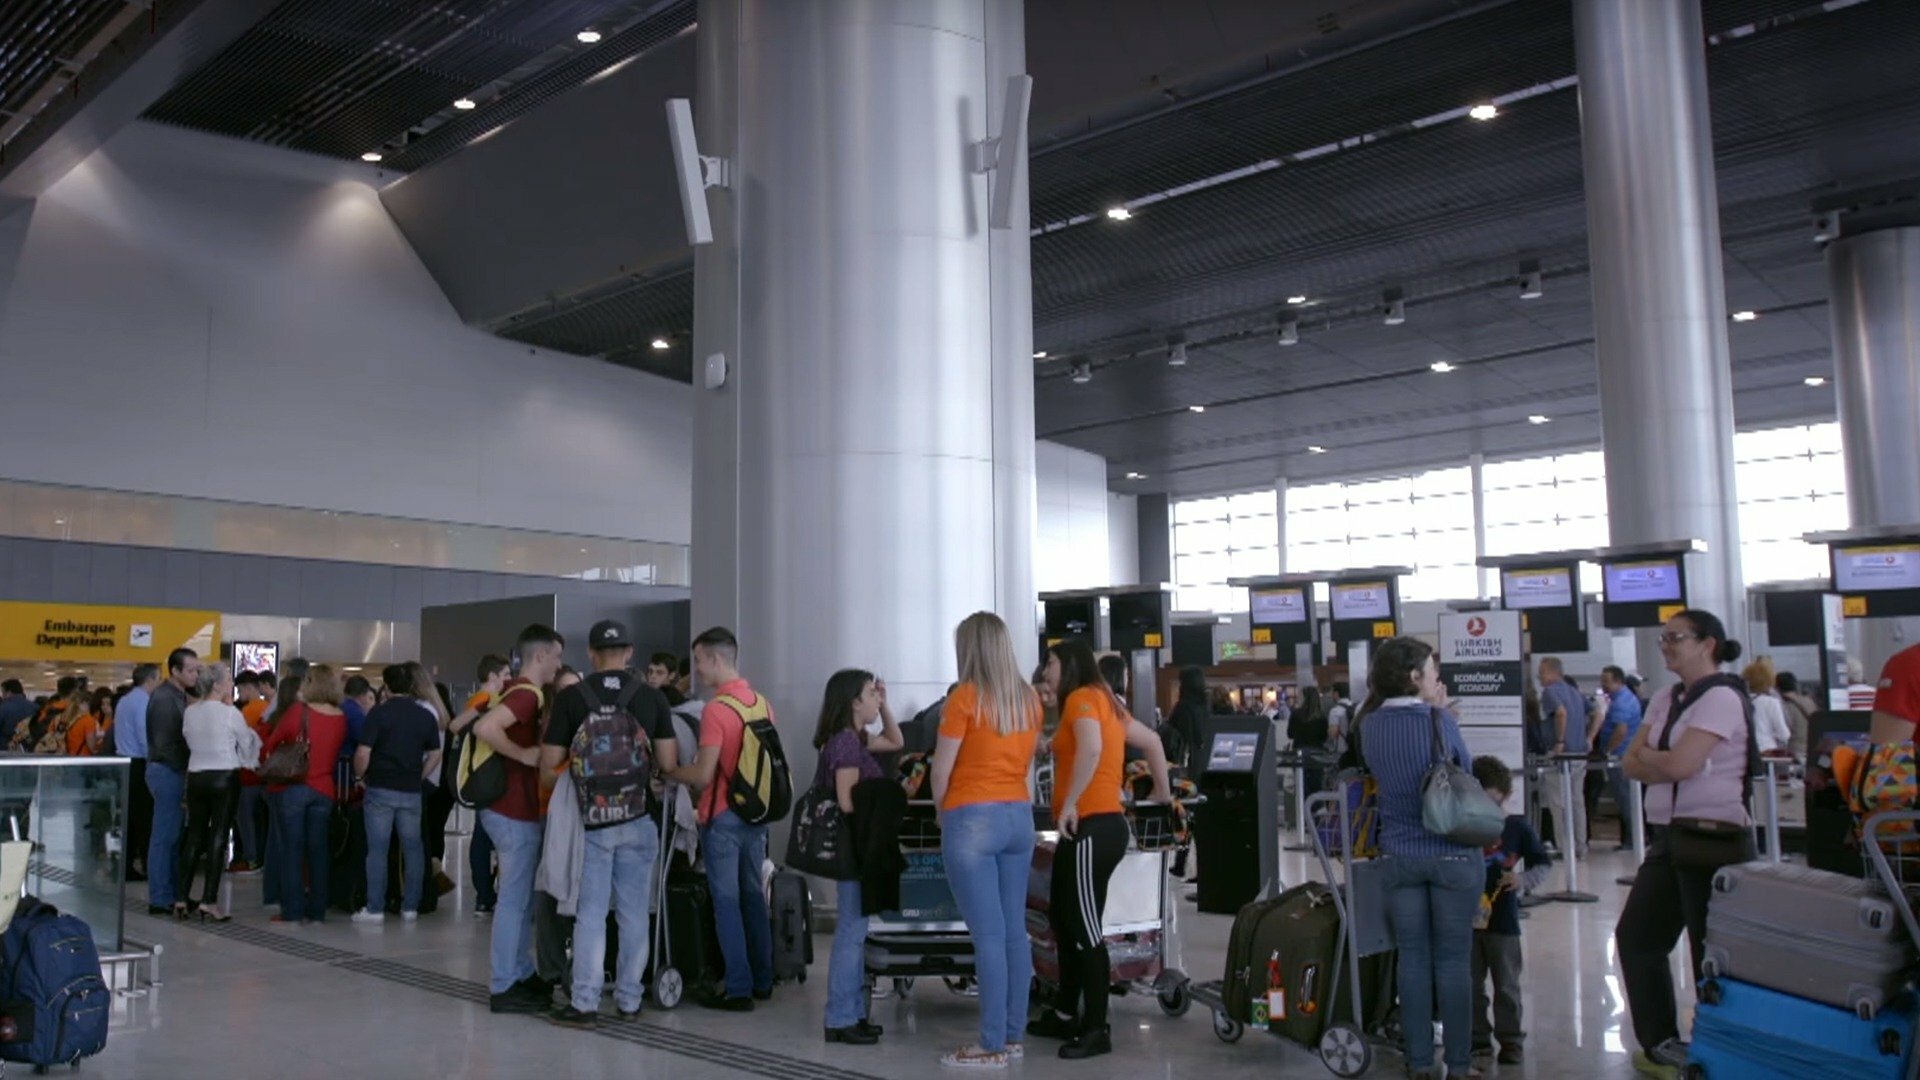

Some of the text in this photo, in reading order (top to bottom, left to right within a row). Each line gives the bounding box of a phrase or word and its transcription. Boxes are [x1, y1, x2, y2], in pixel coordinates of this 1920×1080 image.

[44, 619, 116, 636] Embarque
[37, 634, 115, 649] Departures
[1455, 638, 1502, 648] TURKISH
[1455, 647, 1503, 657] AIRLINES
[1454, 671, 1506, 683] ECONÔMICA
[1458, 683, 1501, 692] ECONOMY
